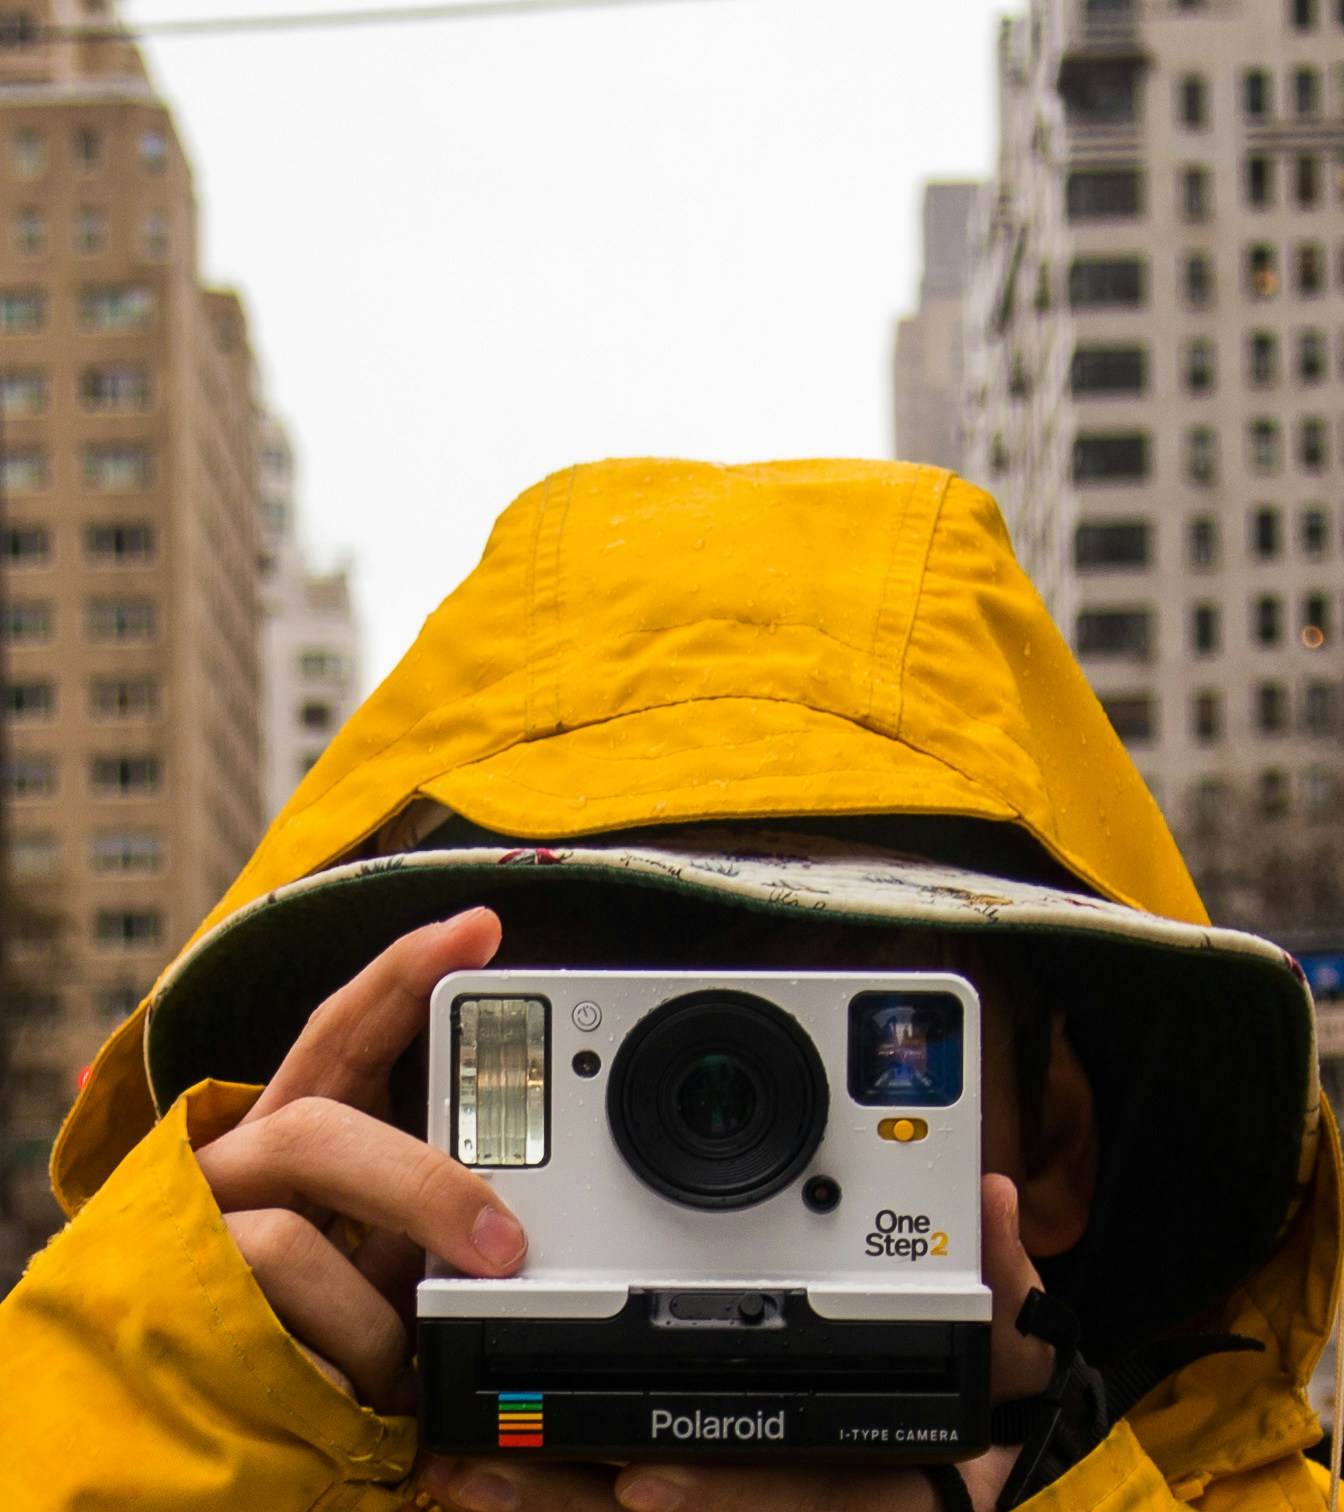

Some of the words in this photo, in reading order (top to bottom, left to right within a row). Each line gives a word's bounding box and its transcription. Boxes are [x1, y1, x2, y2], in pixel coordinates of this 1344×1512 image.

[875, 1209, 931, 1234] One
[651, 1410, 785, 1440] Polaroid
[839, 1429, 889, 1441] I-TYPE
[895, 1429, 959, 1441] CAMERA
